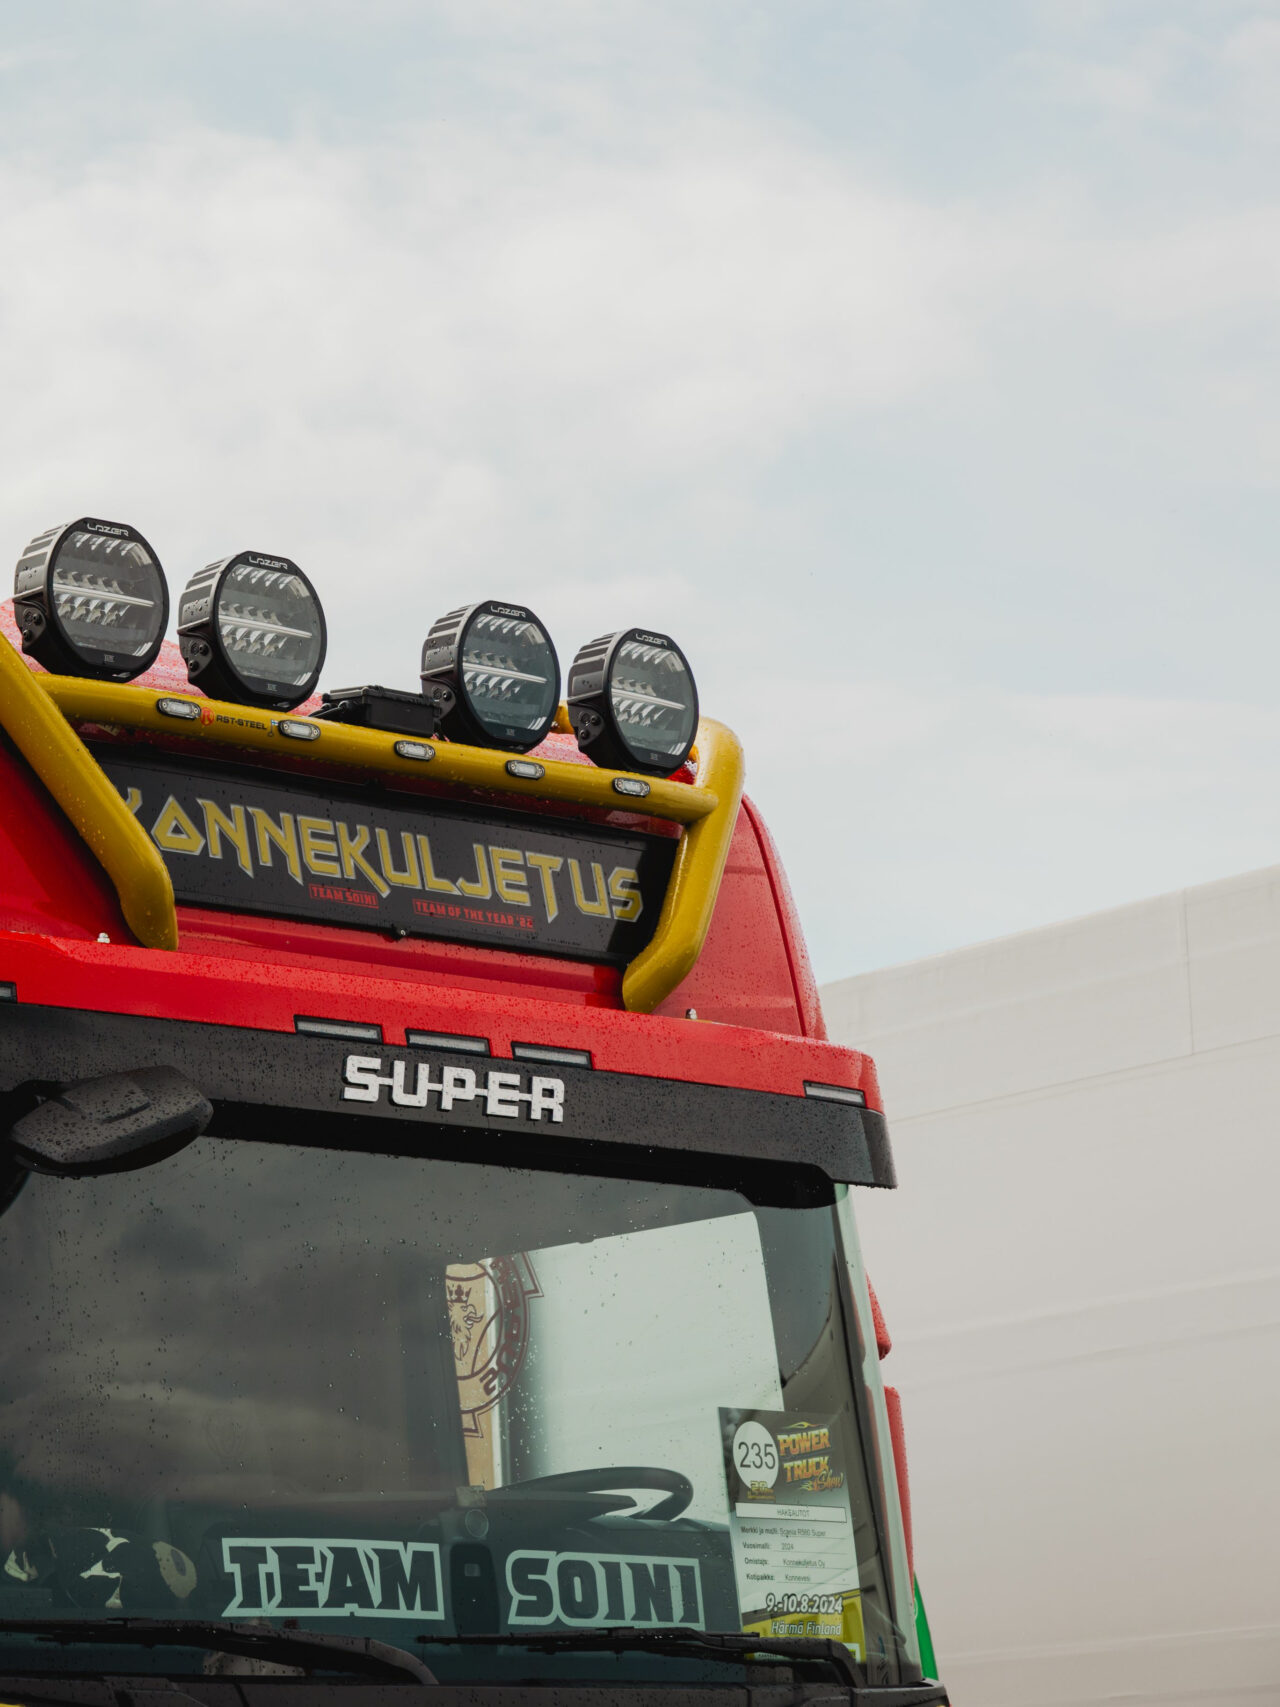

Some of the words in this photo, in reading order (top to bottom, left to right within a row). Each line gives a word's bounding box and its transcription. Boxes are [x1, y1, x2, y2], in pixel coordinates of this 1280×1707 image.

[87, 523, 129, 537] LAZER
[248, 555, 289, 570] LAZER
[490, 605, 526, 618] LAZER
[635, 633, 668, 646] LAZER
[216, 714, 267, 730] RST-STEEL
[311, 886, 344, 901] TEAM
[345, 891, 377, 905] SOINI
[415, 901, 446, 916] TEAM
[448, 906, 461, 918] OF
[463, 908, 485, 921] THE
[486, 911, 514, 926] YEAR
[343, 1055, 565, 1122] SUPER
[738, 1441, 776, 1470] 235
[777, 1428, 831, 1456] POWER
[783, 1456, 830, 1482] TRUCK
[222, 1537, 445, 1620] TEAM
[506, 1549, 705, 1631] SOINI
[766, 1593, 843, 1614] 9.-10.8.2024
[806, 1622, 842, 1636] Finland
